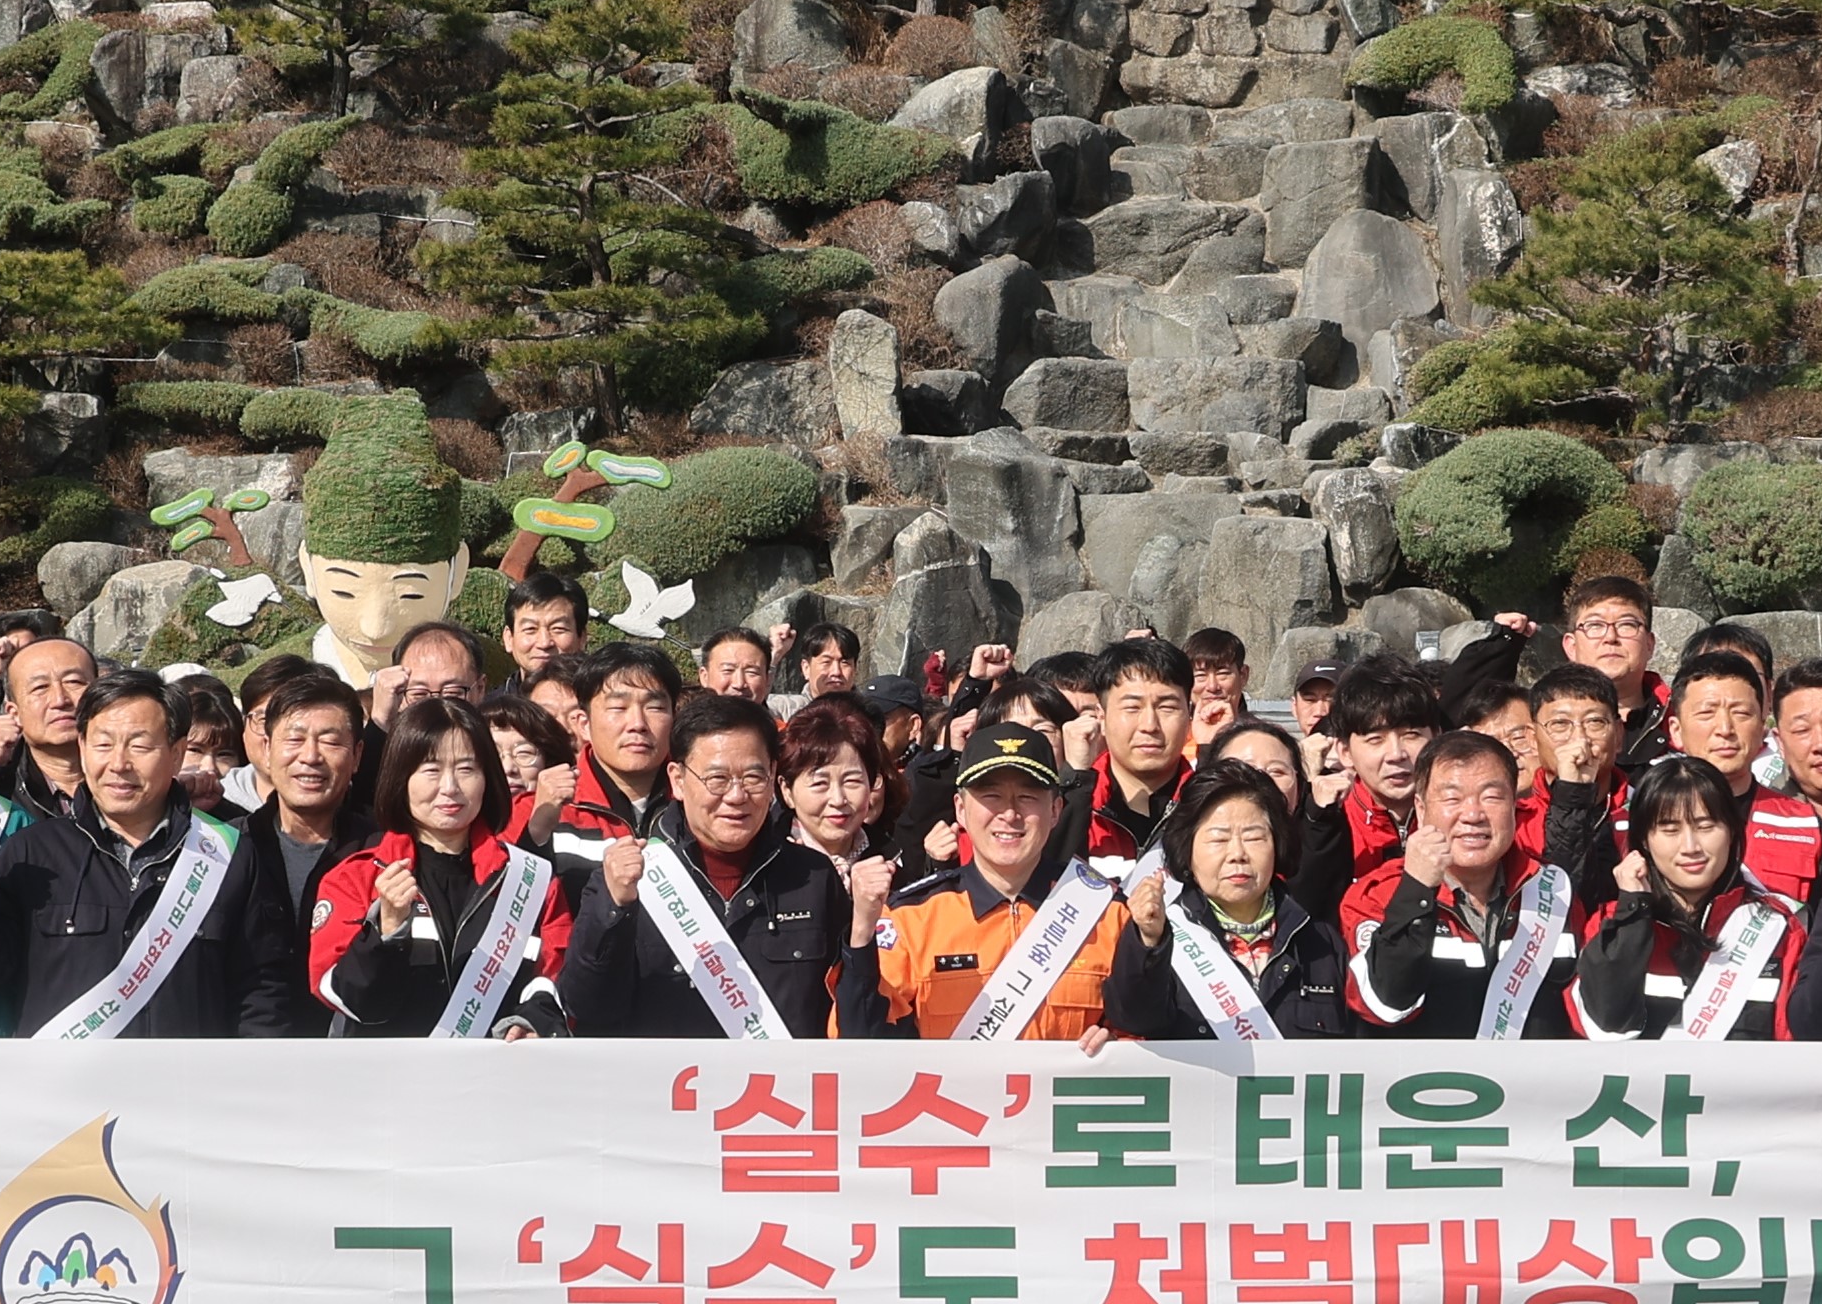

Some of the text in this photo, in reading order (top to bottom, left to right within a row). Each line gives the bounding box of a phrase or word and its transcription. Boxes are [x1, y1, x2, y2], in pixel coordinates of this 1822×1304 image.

[59, 859, 210, 1040] 산불나면 자연파괴 산불내
[450, 856, 541, 1039] 산불나면 자연파괴 산불
[646, 868, 701, 939] 이득없는
[692, 939, 750, 1010] 논밭소각
[1027, 901, 1080, 974] 푸른숲,
[1504, 922, 1546, 998] 자연파괴
[1006, 970, 1033, 997] 그
[1491, 998, 1515, 1040] 산불
[1687, 969, 1739, 1040] 설마설마
[672, 1066, 1741, 1197] ‘실수’로 태운 산,
